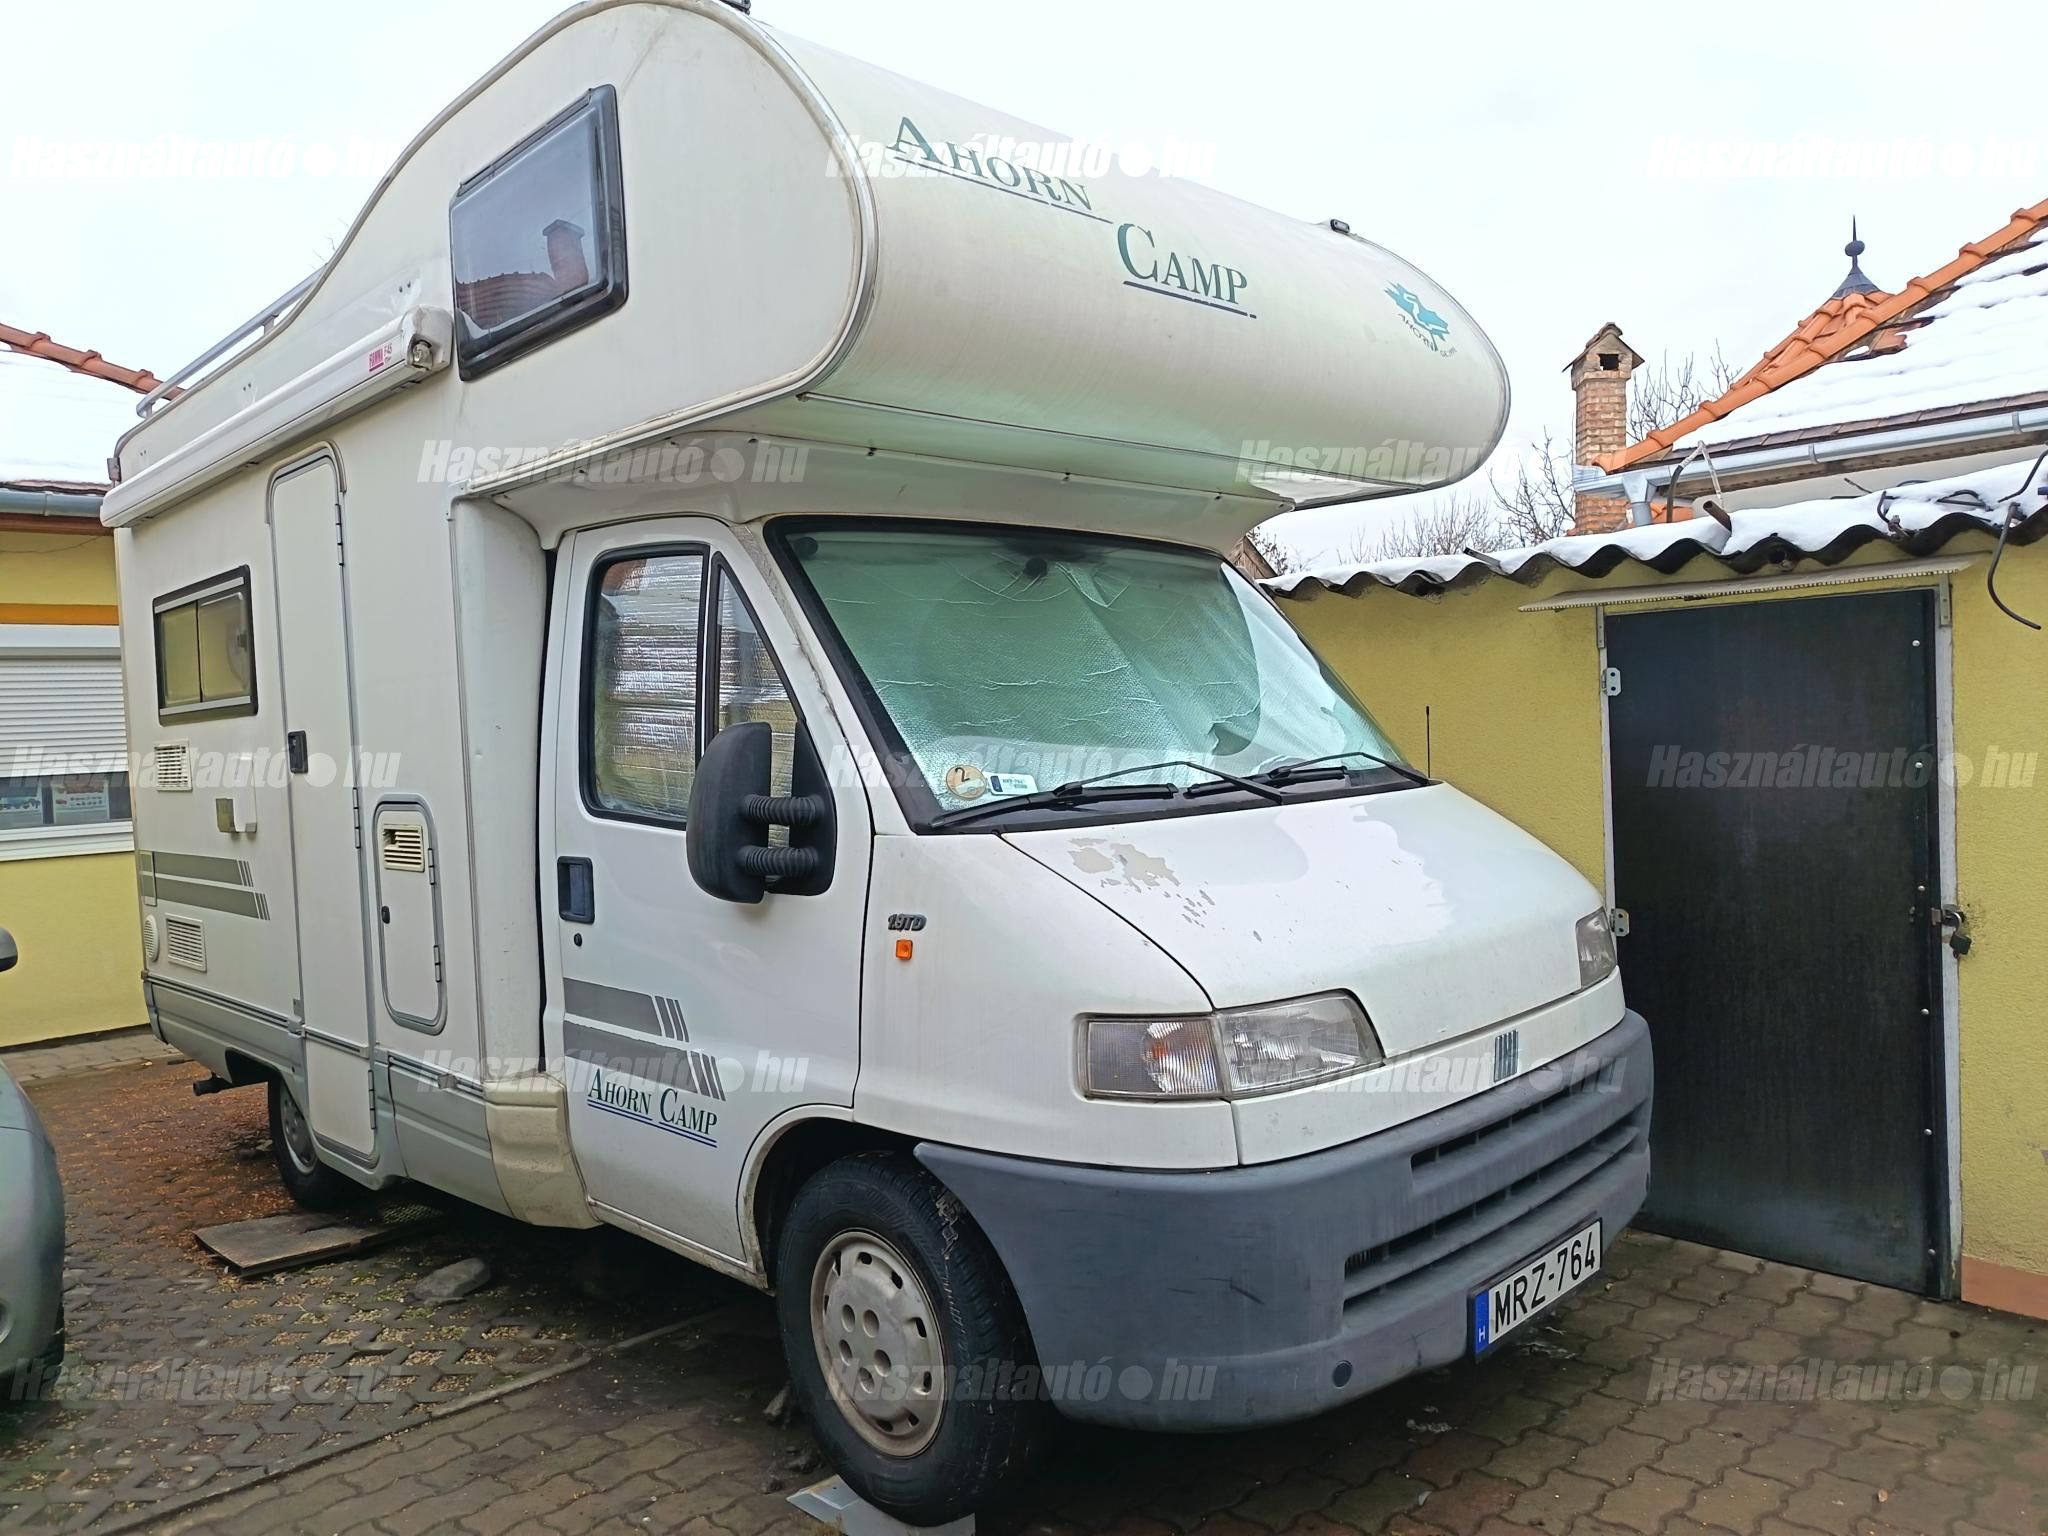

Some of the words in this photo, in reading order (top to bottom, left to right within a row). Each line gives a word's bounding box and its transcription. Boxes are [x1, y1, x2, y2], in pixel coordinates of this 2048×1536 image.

[886, 116, 1092, 210] AHORN
[1117, 223, 1247, 304] CAMP
[954, 766, 970, 783] 2
[588, 1068, 651, 1115] AHORN
[660, 1088, 718, 1135] CAMP
[1494, 1231, 1595, 1334] MRZ-764
[1478, 1326, 1486, 1342] H
